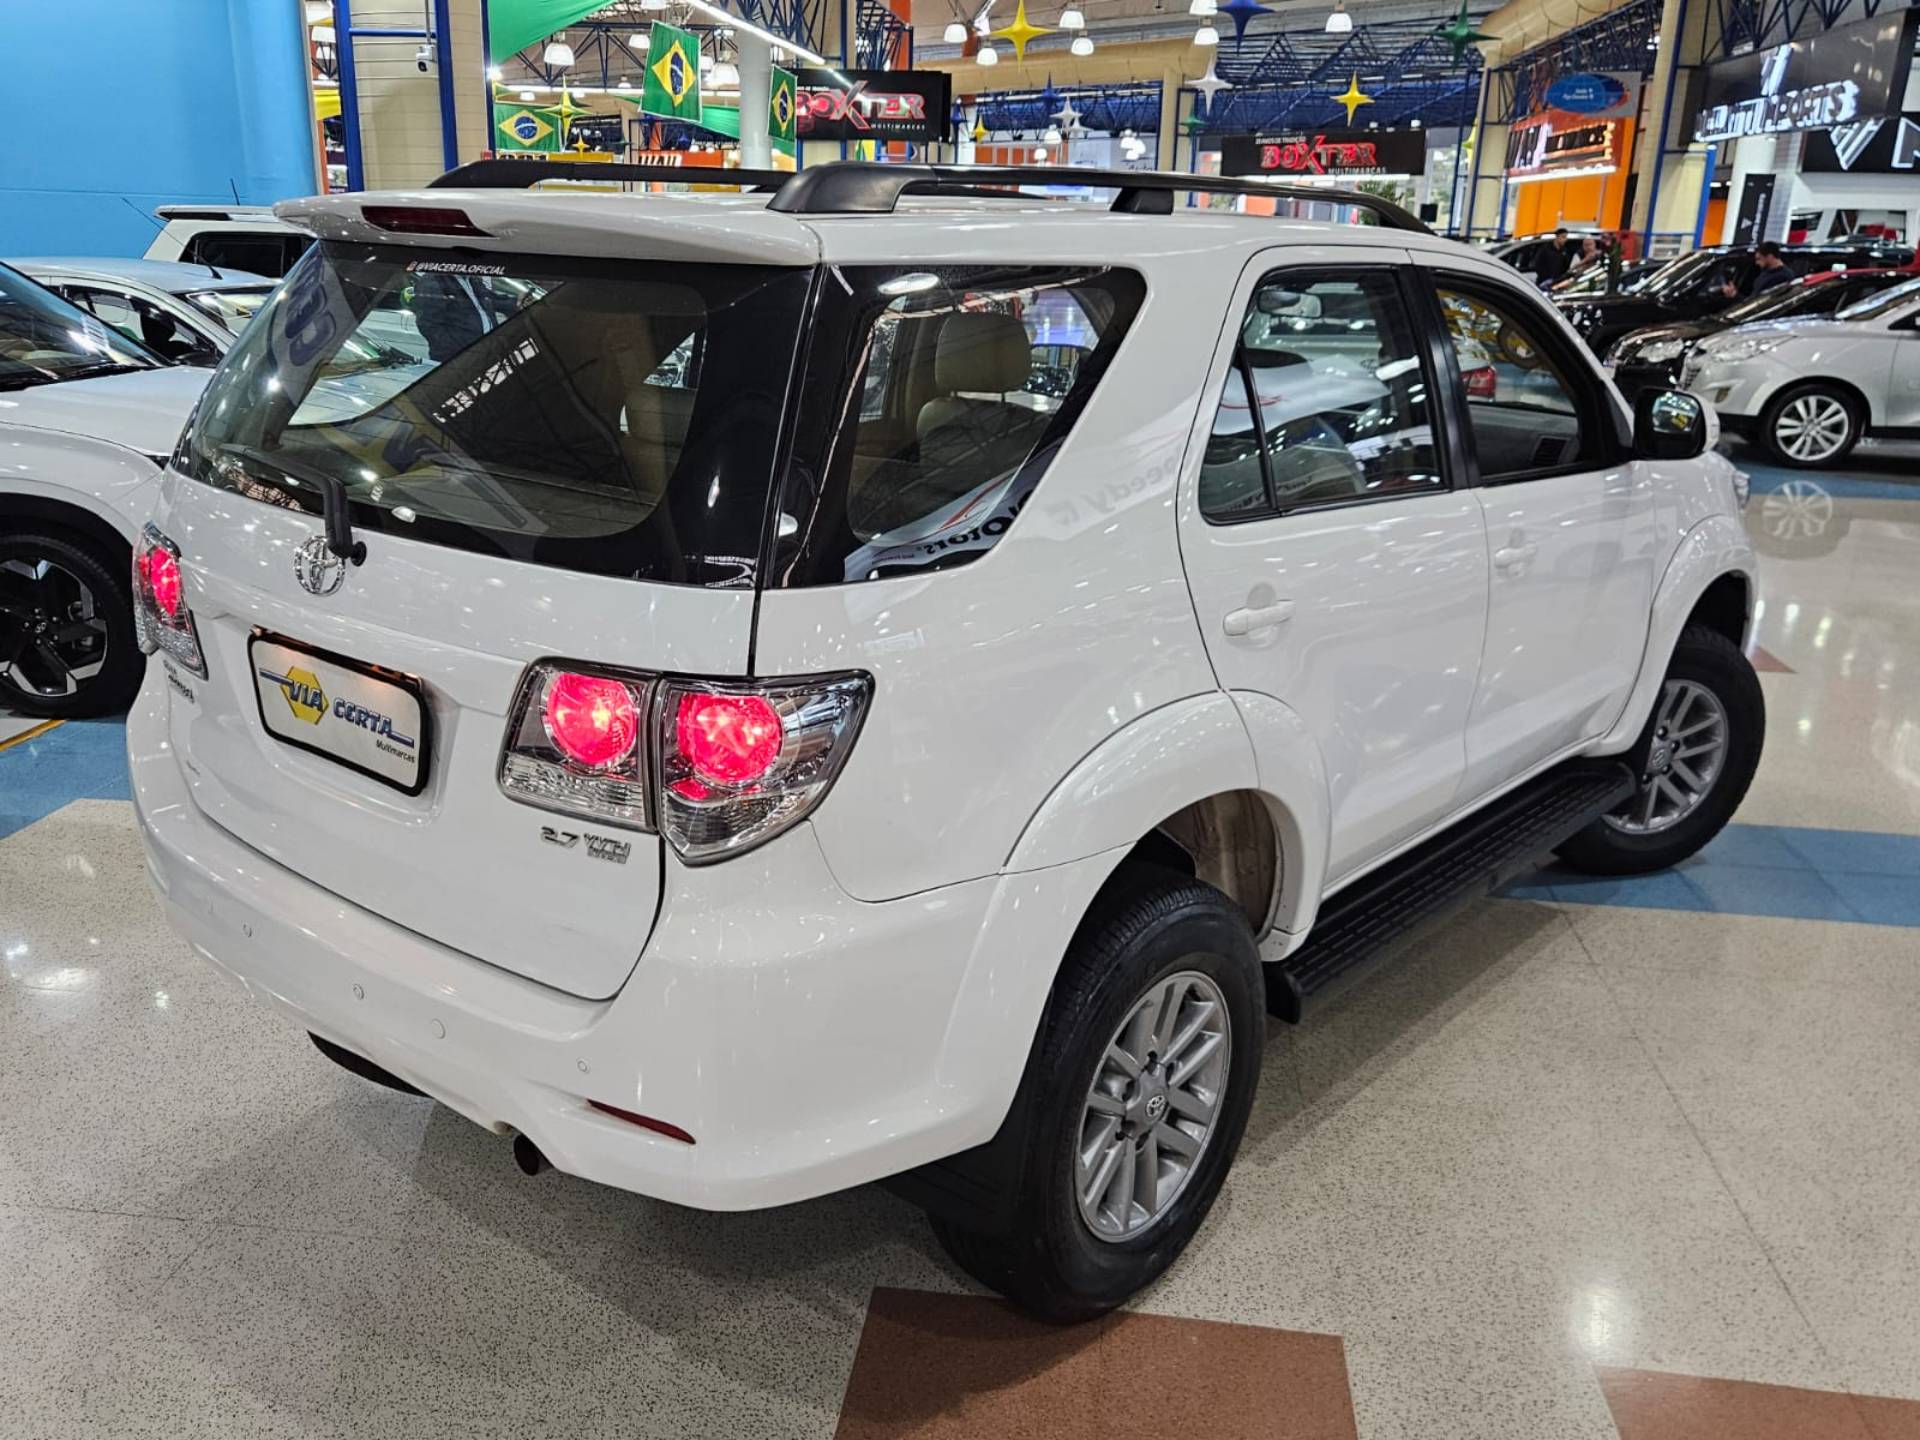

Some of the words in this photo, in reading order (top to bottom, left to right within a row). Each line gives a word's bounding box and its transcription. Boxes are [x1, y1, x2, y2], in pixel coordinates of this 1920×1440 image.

[1260, 134, 1377, 174] BOXTER
[288, 678, 325, 713] VIA
[333, 696, 393, 738] CERTA
[375, 739, 416, 764] Multimarcas
